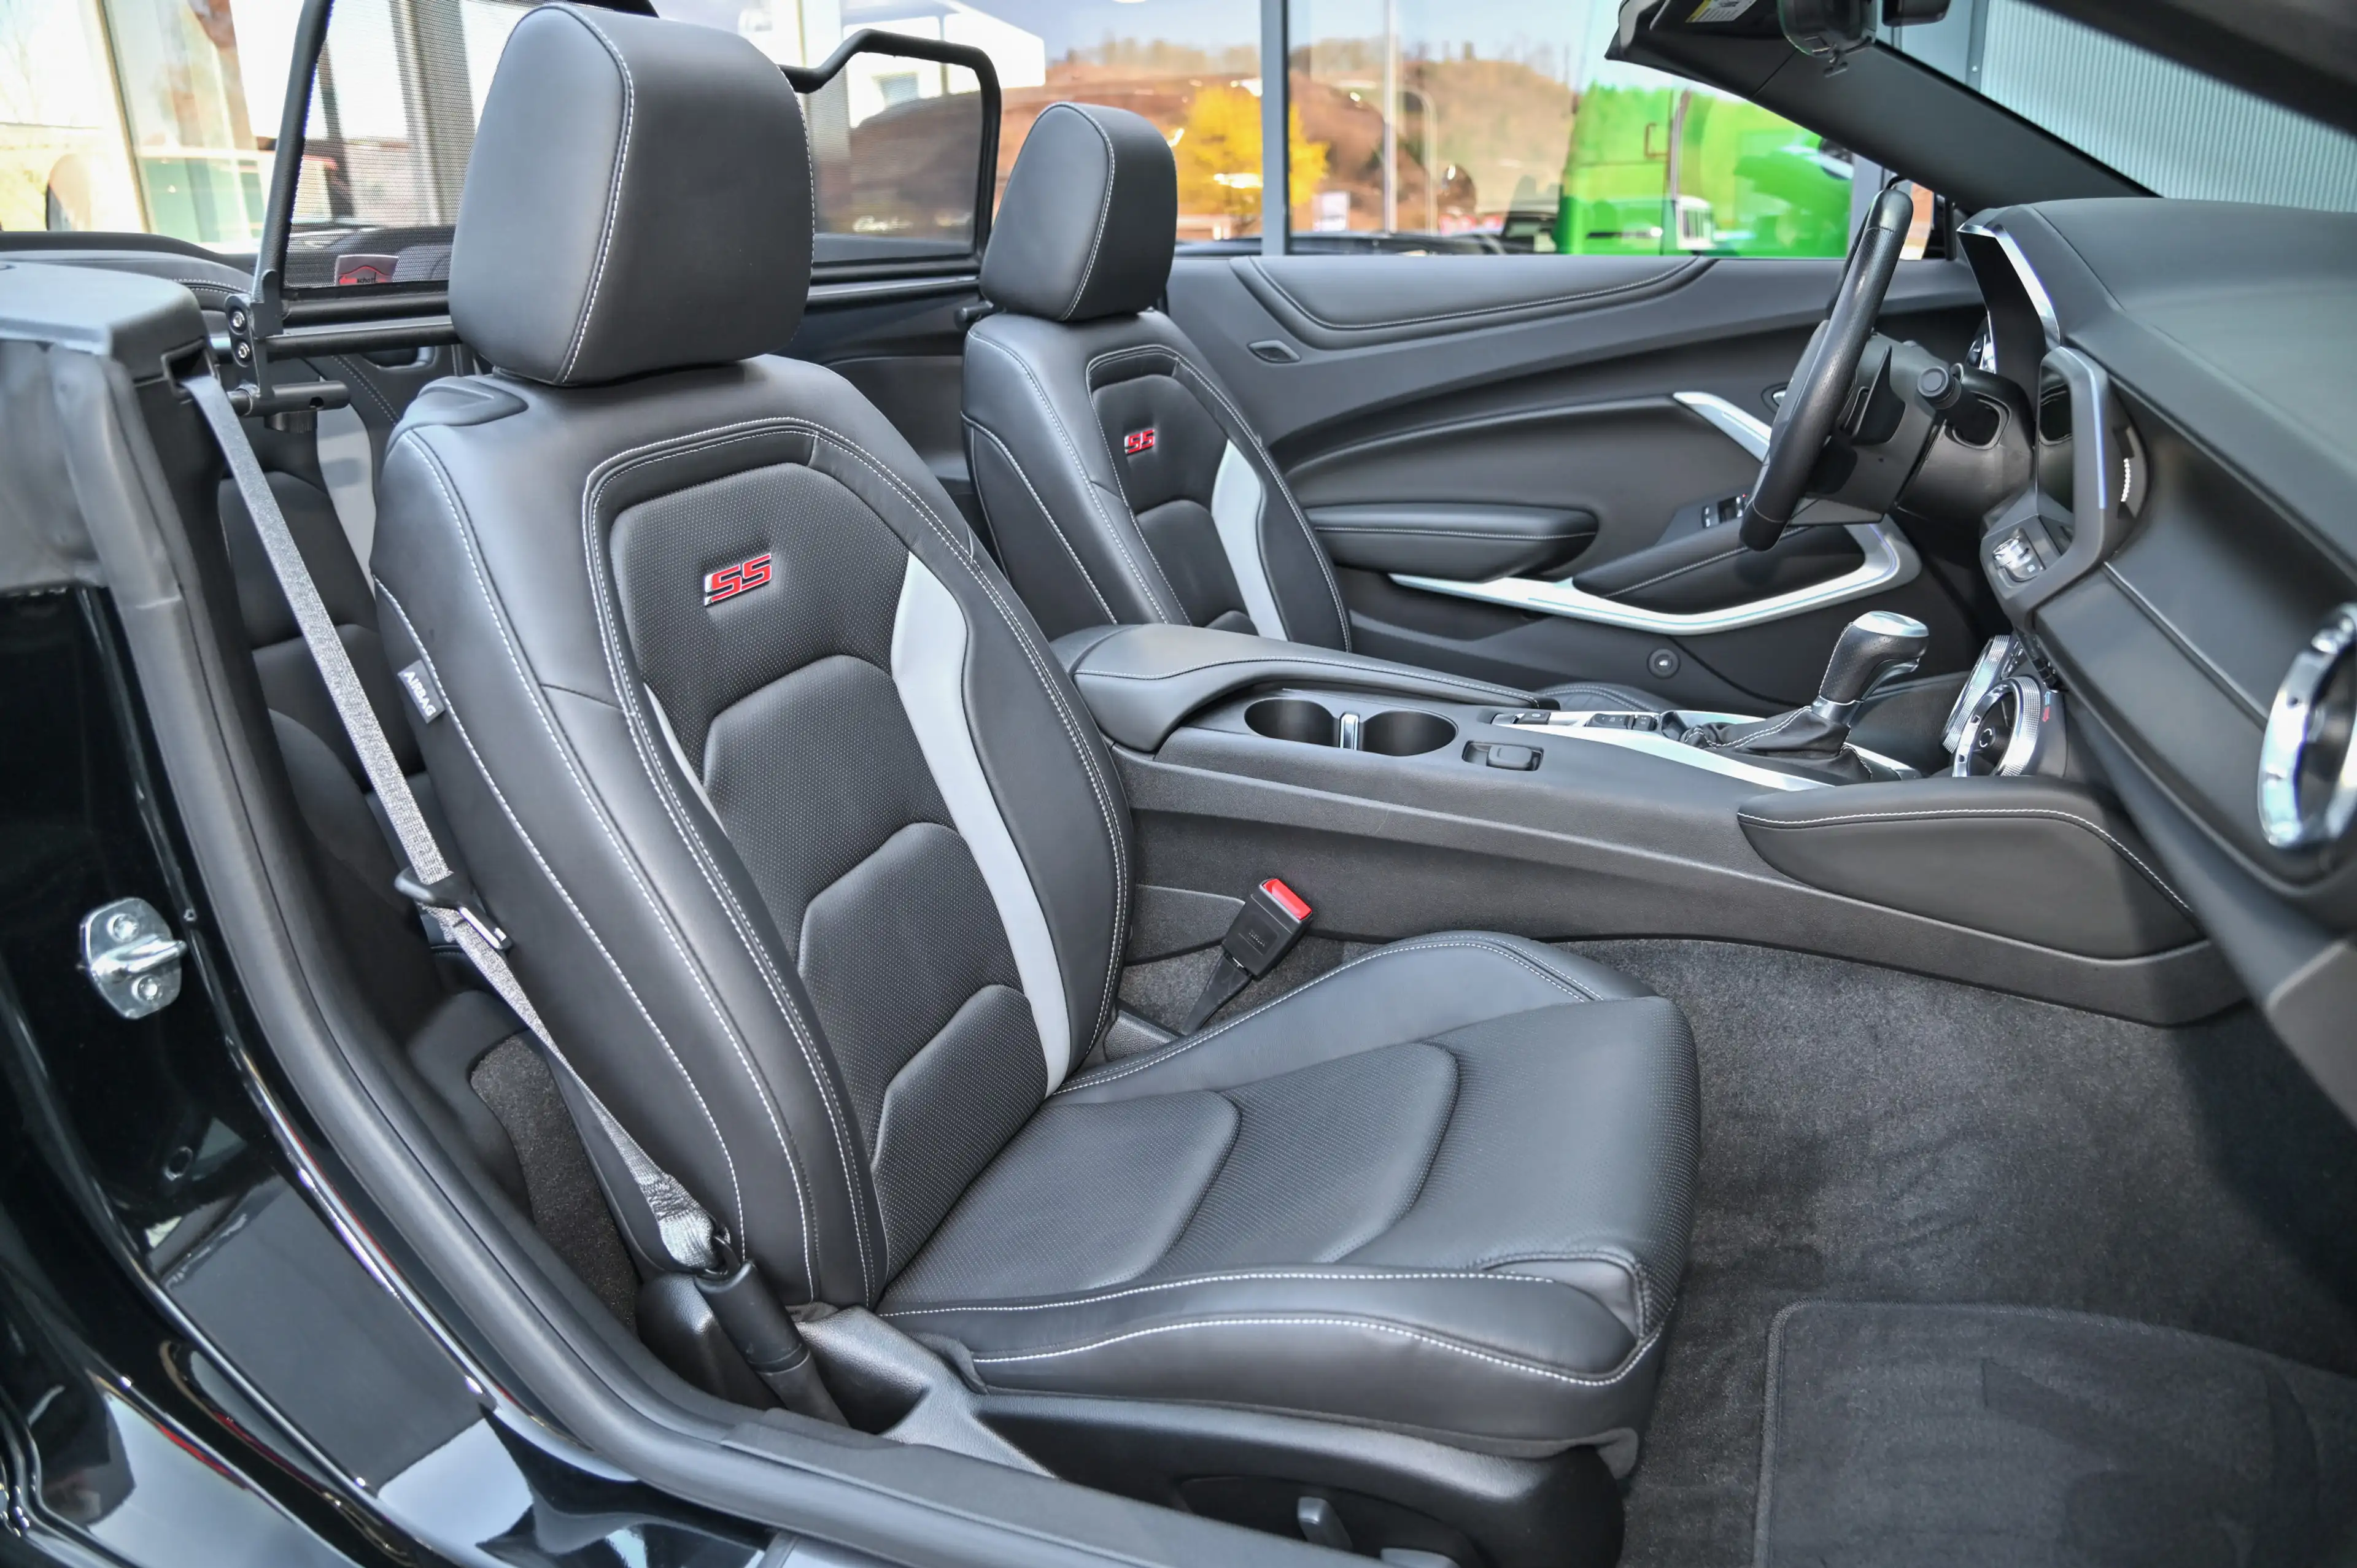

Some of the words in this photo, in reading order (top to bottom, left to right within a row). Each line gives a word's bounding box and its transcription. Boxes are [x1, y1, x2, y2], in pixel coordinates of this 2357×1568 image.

[1124, 428, 1155, 454] SS
[705, 553, 772, 606] SS
[404, 671, 436, 717] AIRBAG
